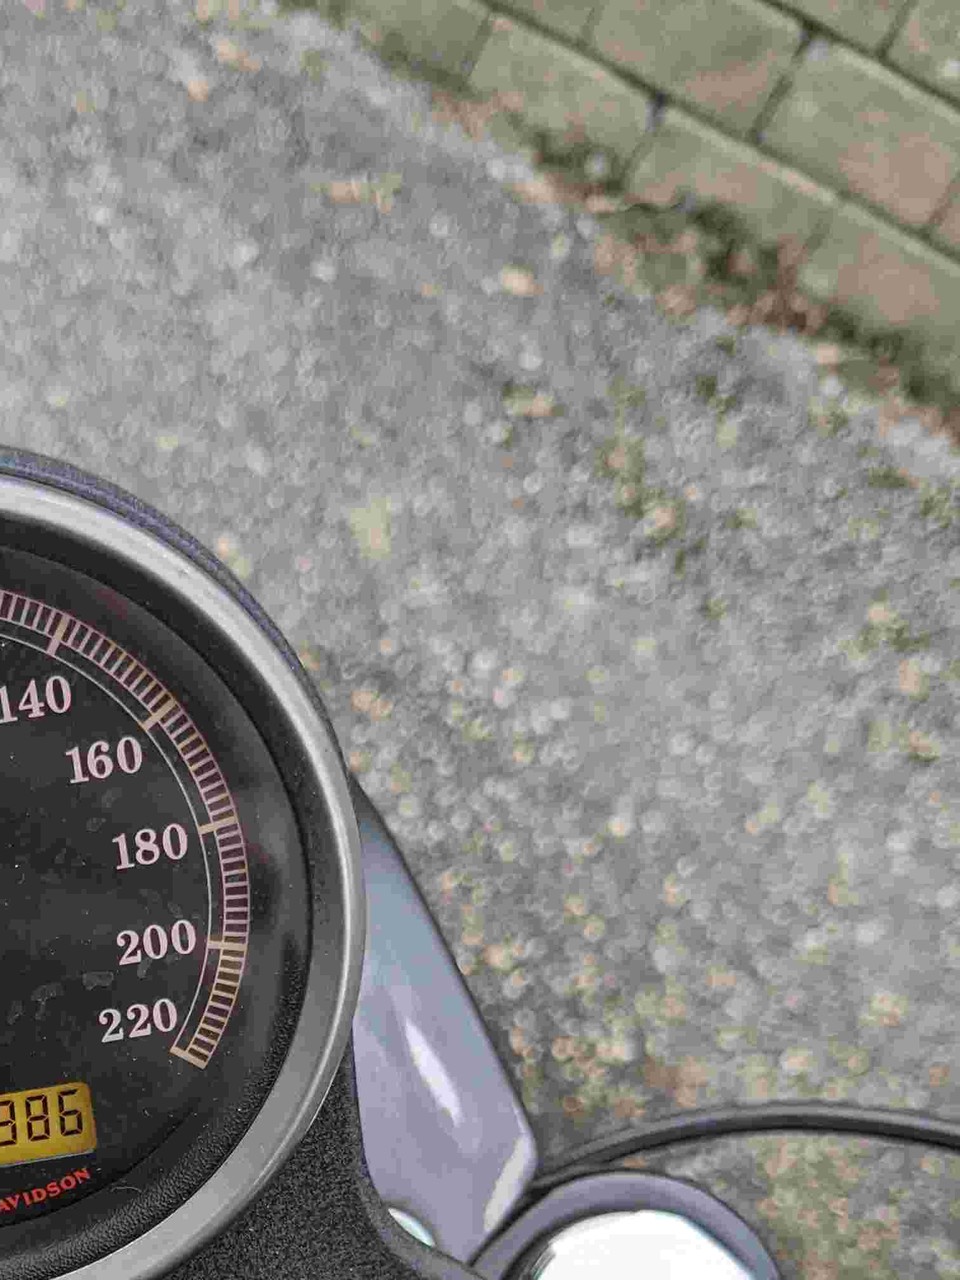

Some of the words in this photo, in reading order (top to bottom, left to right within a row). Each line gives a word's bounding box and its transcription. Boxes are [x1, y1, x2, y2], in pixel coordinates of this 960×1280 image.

[65, 737, 142, 784] 160
[112, 823, 188, 870] 180
[116, 920, 196, 966] 200
[98, 998, 177, 1043] 220
